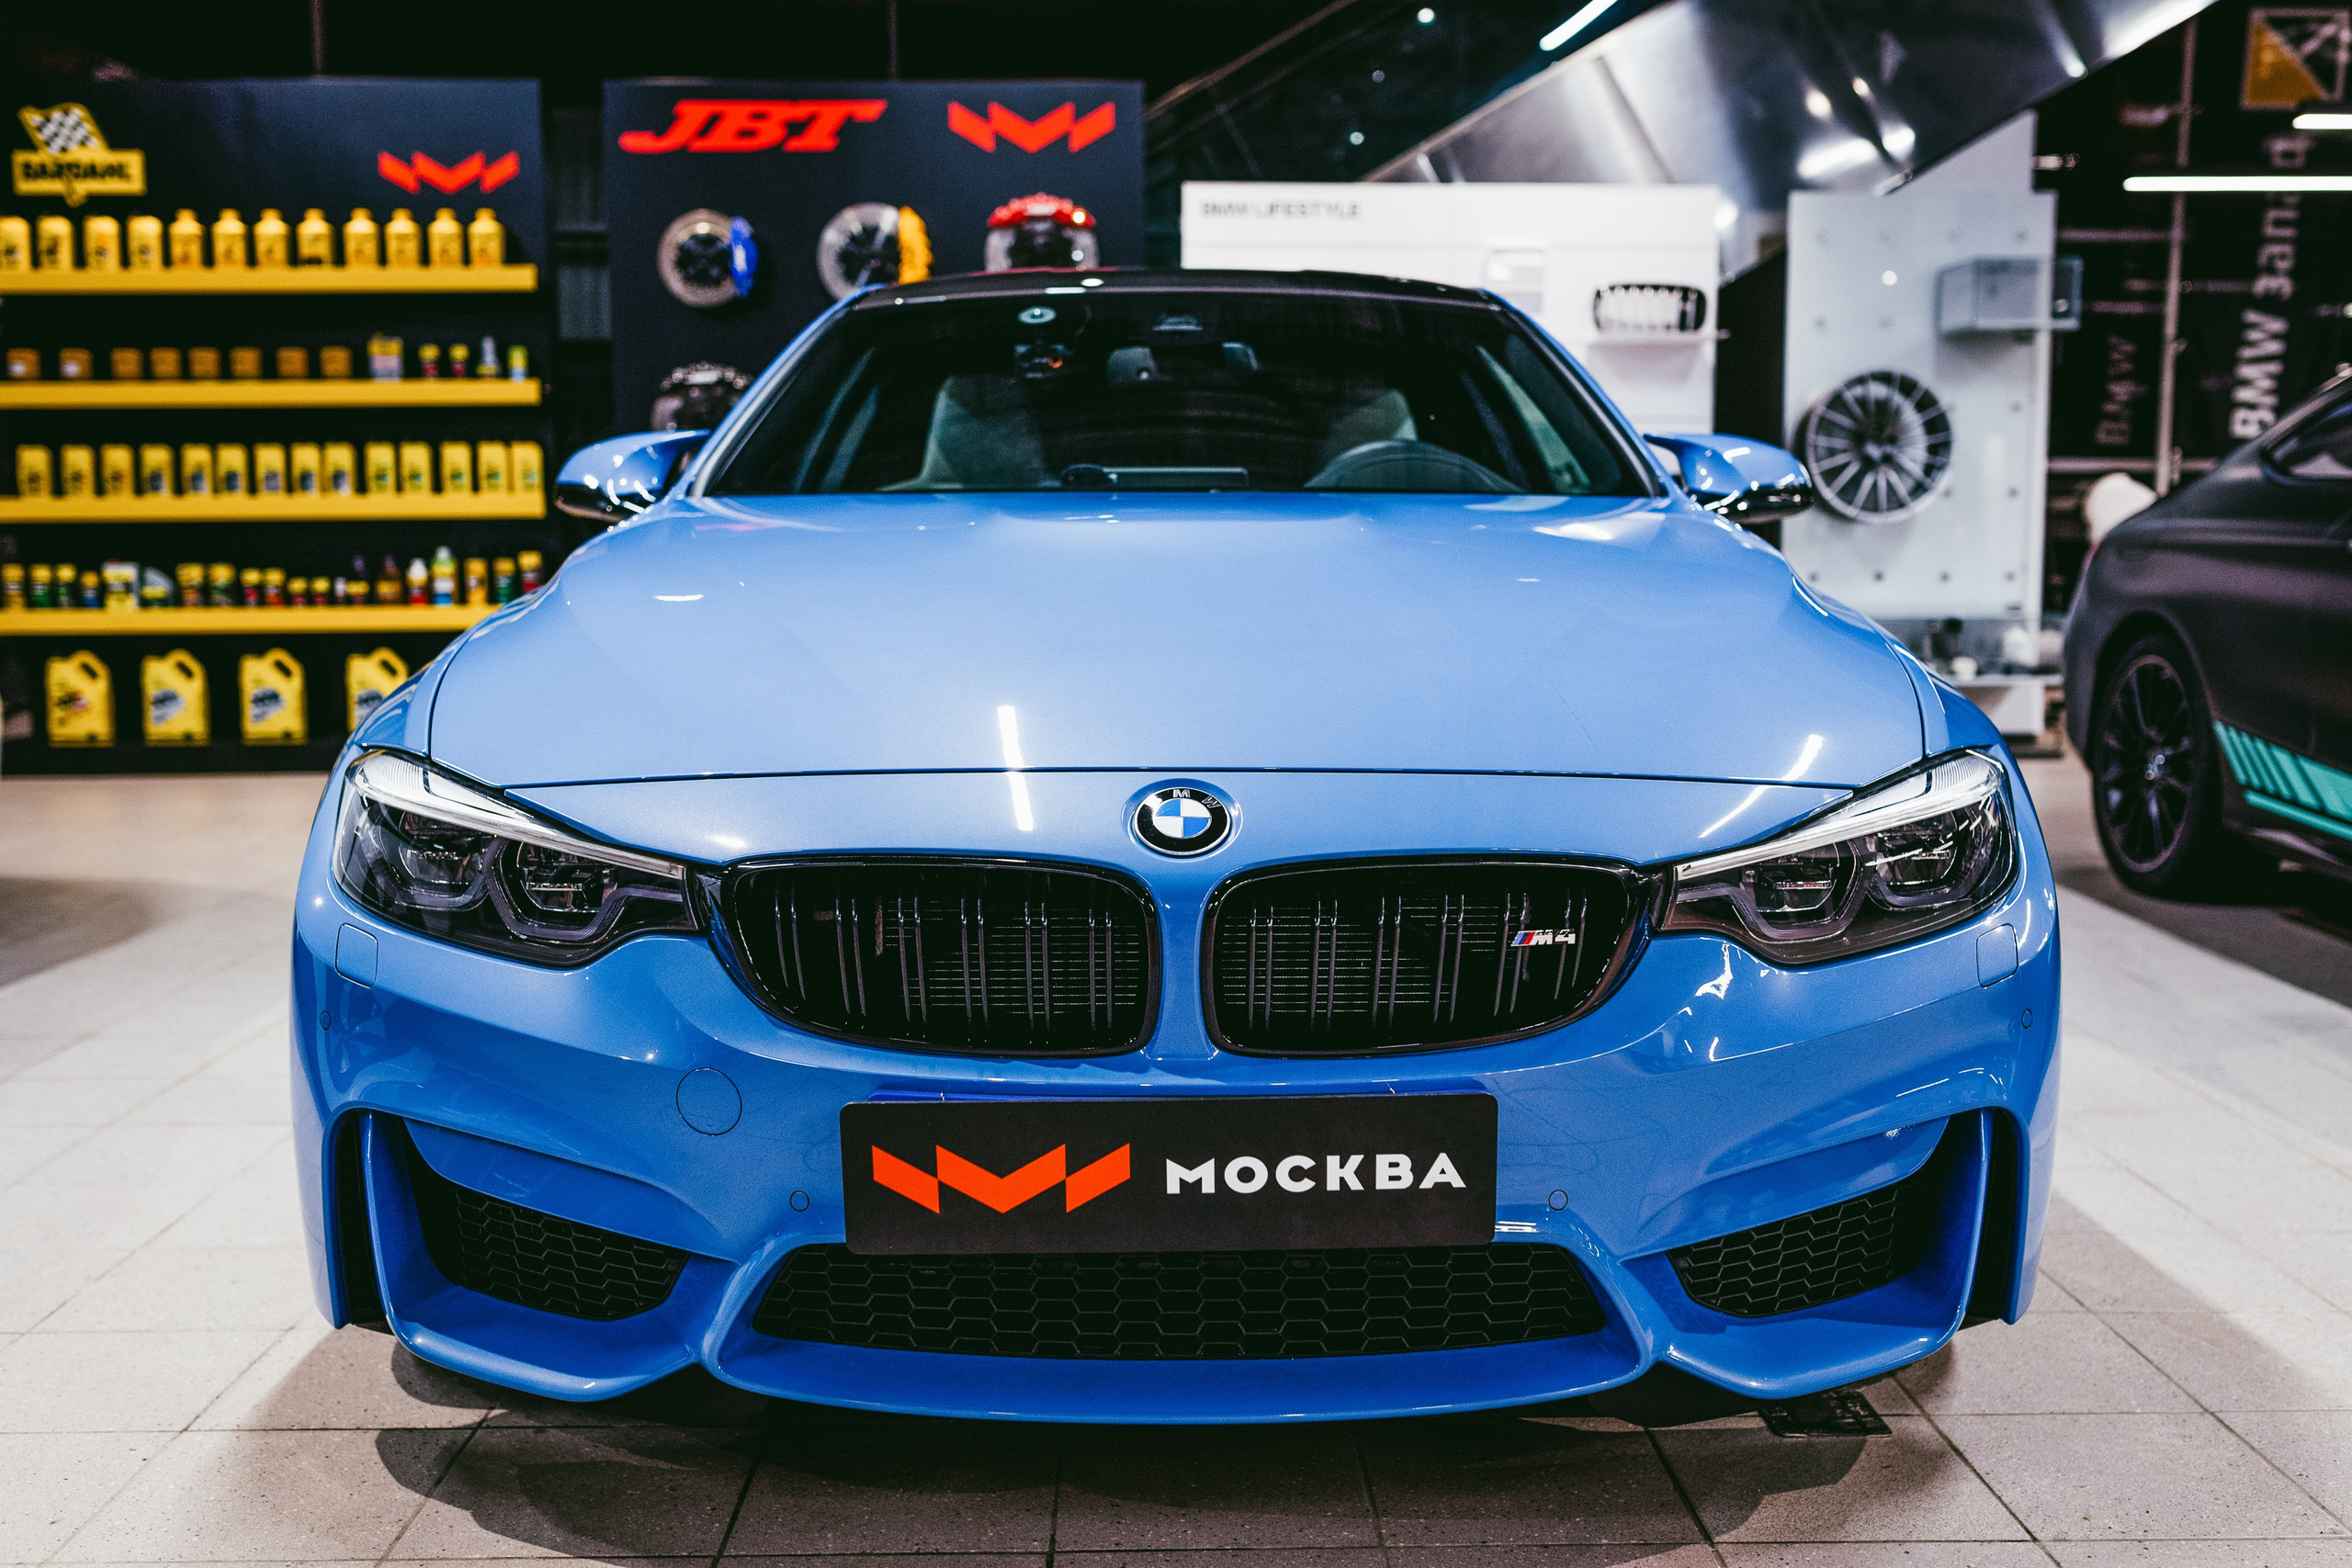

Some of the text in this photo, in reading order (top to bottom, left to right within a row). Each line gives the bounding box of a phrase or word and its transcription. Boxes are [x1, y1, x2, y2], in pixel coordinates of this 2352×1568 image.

[618, 99, 888, 153] JBT
[2229, 309, 2290, 439] BMW
[1523, 929, 1577, 946] M4
[1166, 1152, 1466, 1194] МОСКВА
